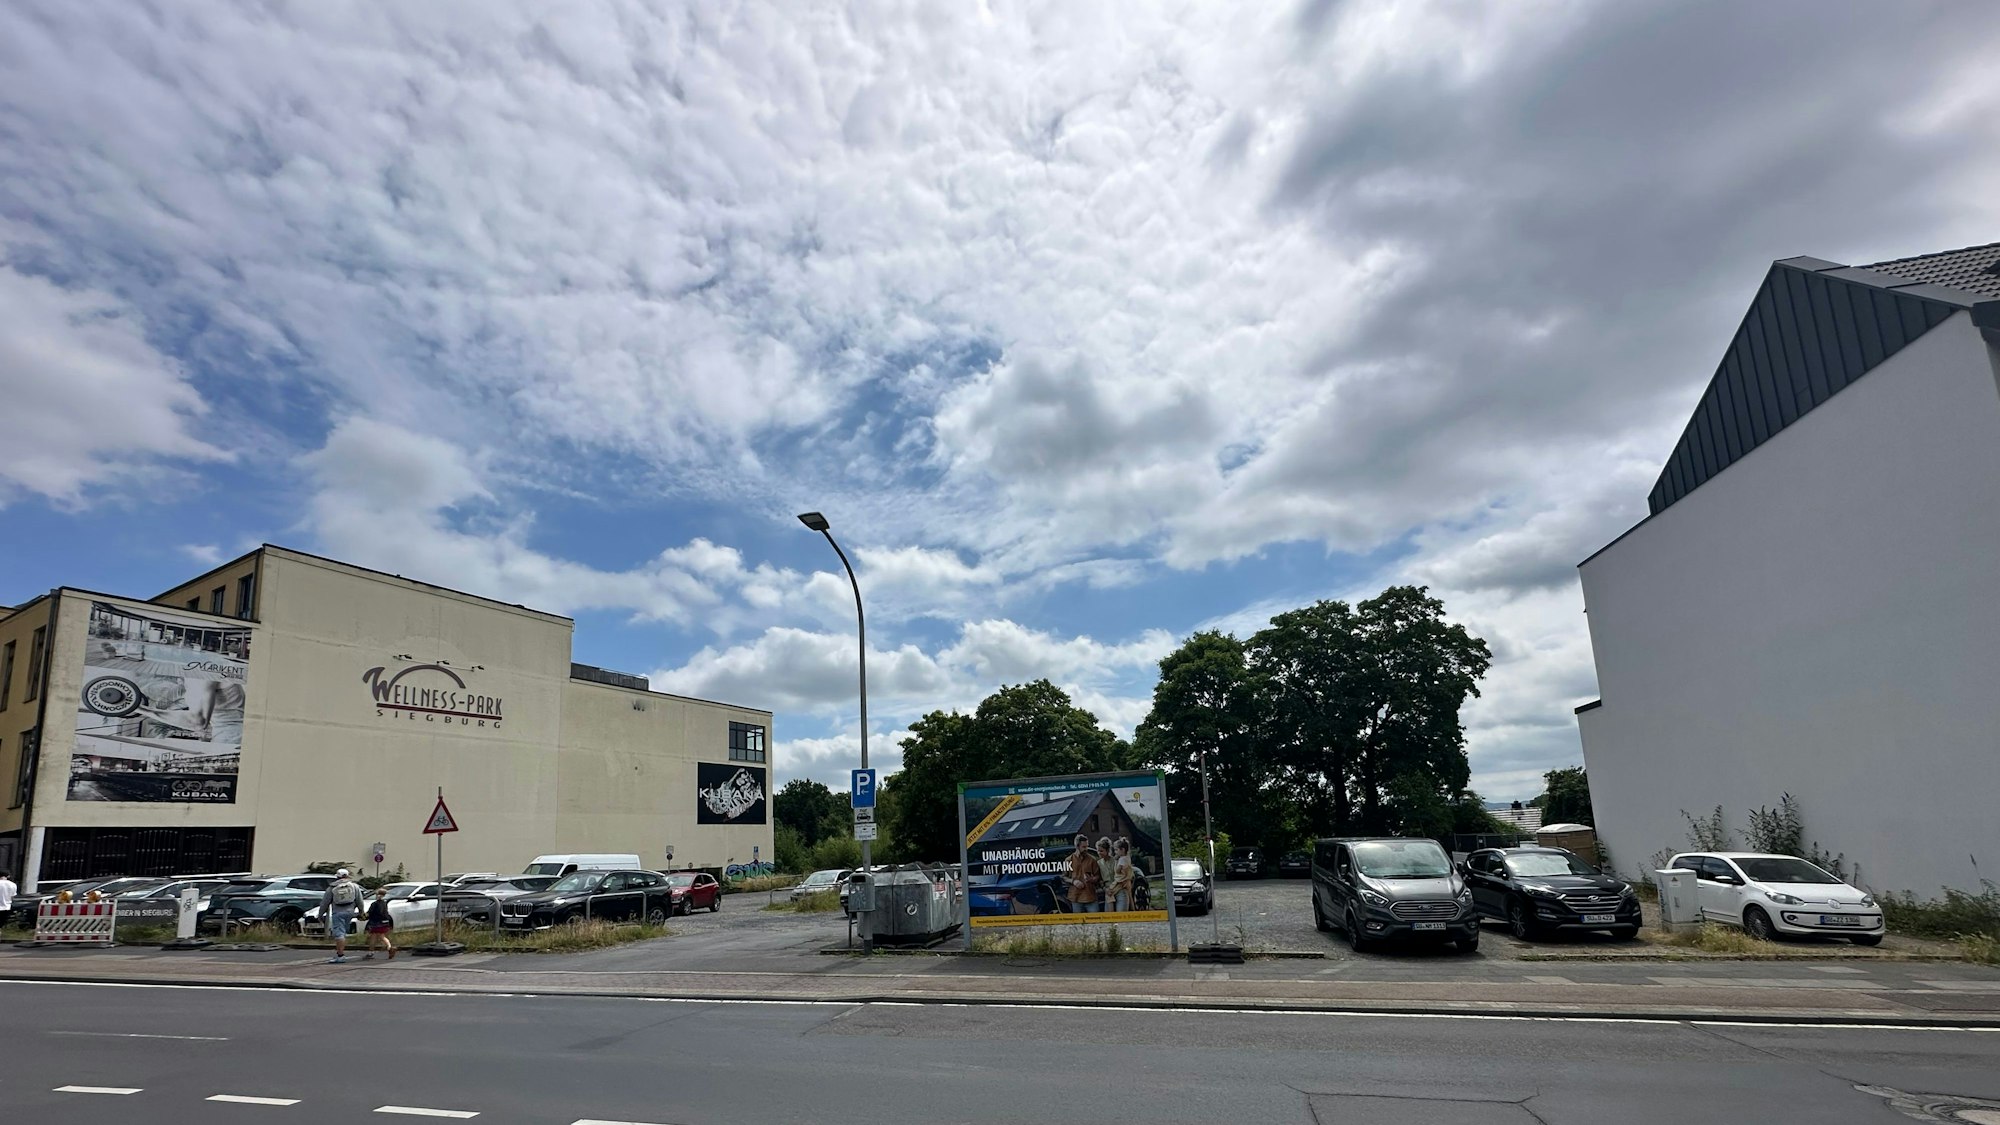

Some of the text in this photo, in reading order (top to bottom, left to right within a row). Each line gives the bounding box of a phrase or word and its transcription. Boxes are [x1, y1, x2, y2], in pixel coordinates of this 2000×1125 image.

[183, 661, 244, 675] MARIVENT
[362, 664, 502, 716] WELLNESS-PARK
[376, 709, 502, 729] SIEGBURG
[856, 772, 871, 796] P
[699, 786, 765, 801] KUBANA
[982, 847, 1046, 862] UNABHÄNGIG
[982, 861, 1074, 875] MIT PHOTOVOLTAIK
[141, 908, 173, 917] SIEGBURG
